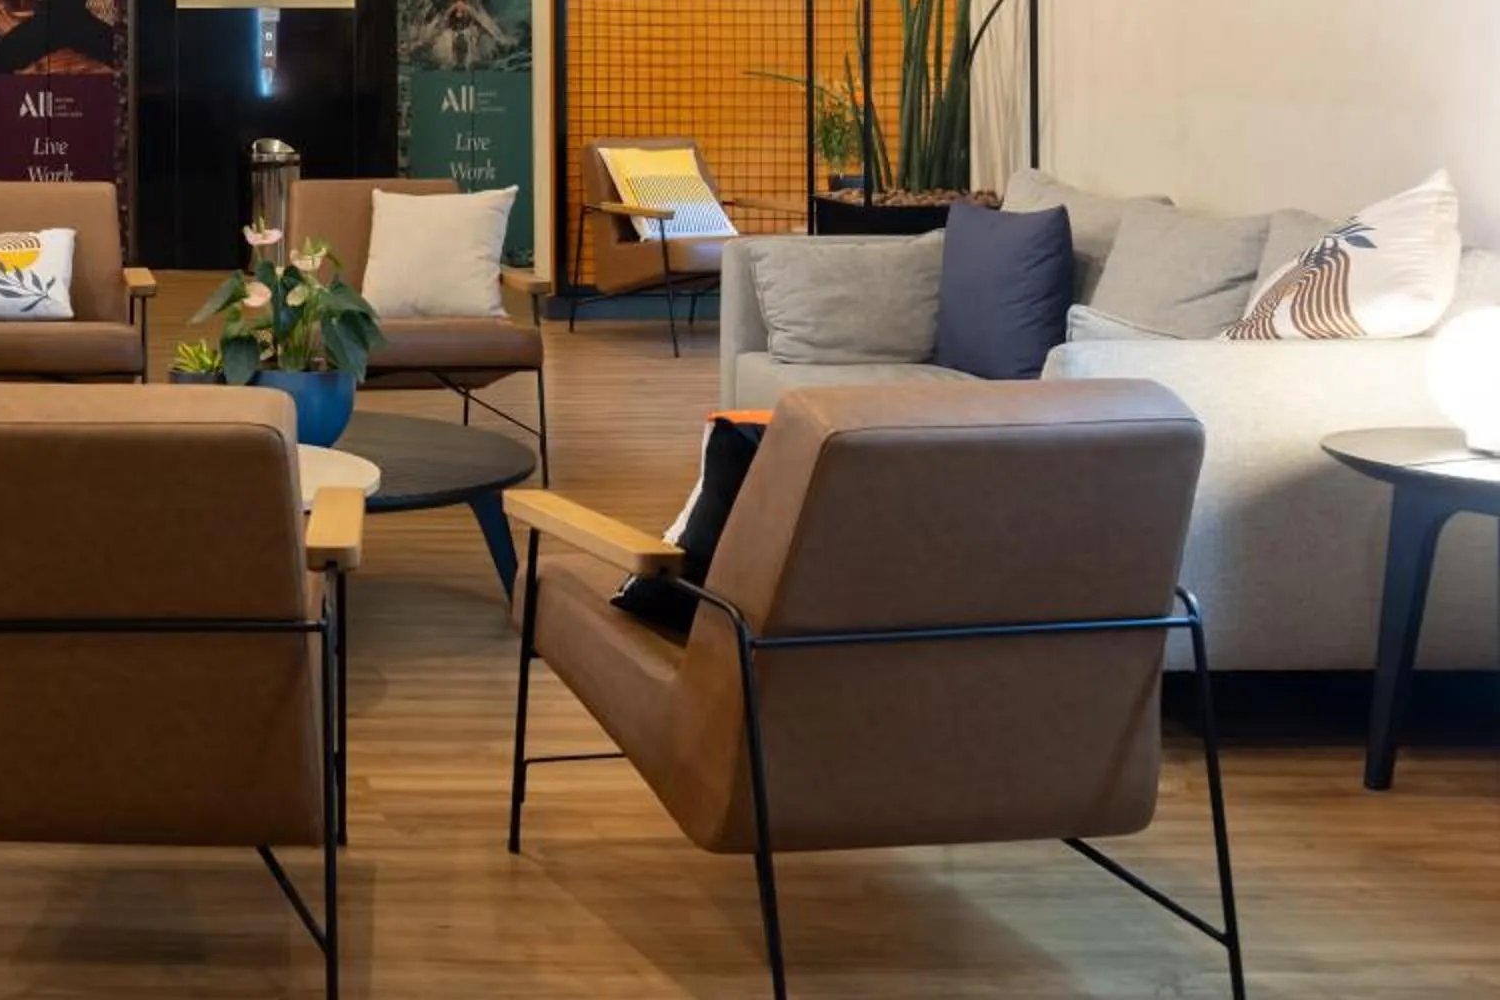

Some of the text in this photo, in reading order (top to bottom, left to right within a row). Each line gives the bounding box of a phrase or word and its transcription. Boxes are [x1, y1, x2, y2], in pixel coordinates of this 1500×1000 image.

[19, 90, 53, 118] All
[441, 85, 474, 112] All
[33, 137, 69, 155] Live
[455, 132, 491, 151] Live
[28, 163, 74, 182] Work
[450, 159, 496, 180] Work
